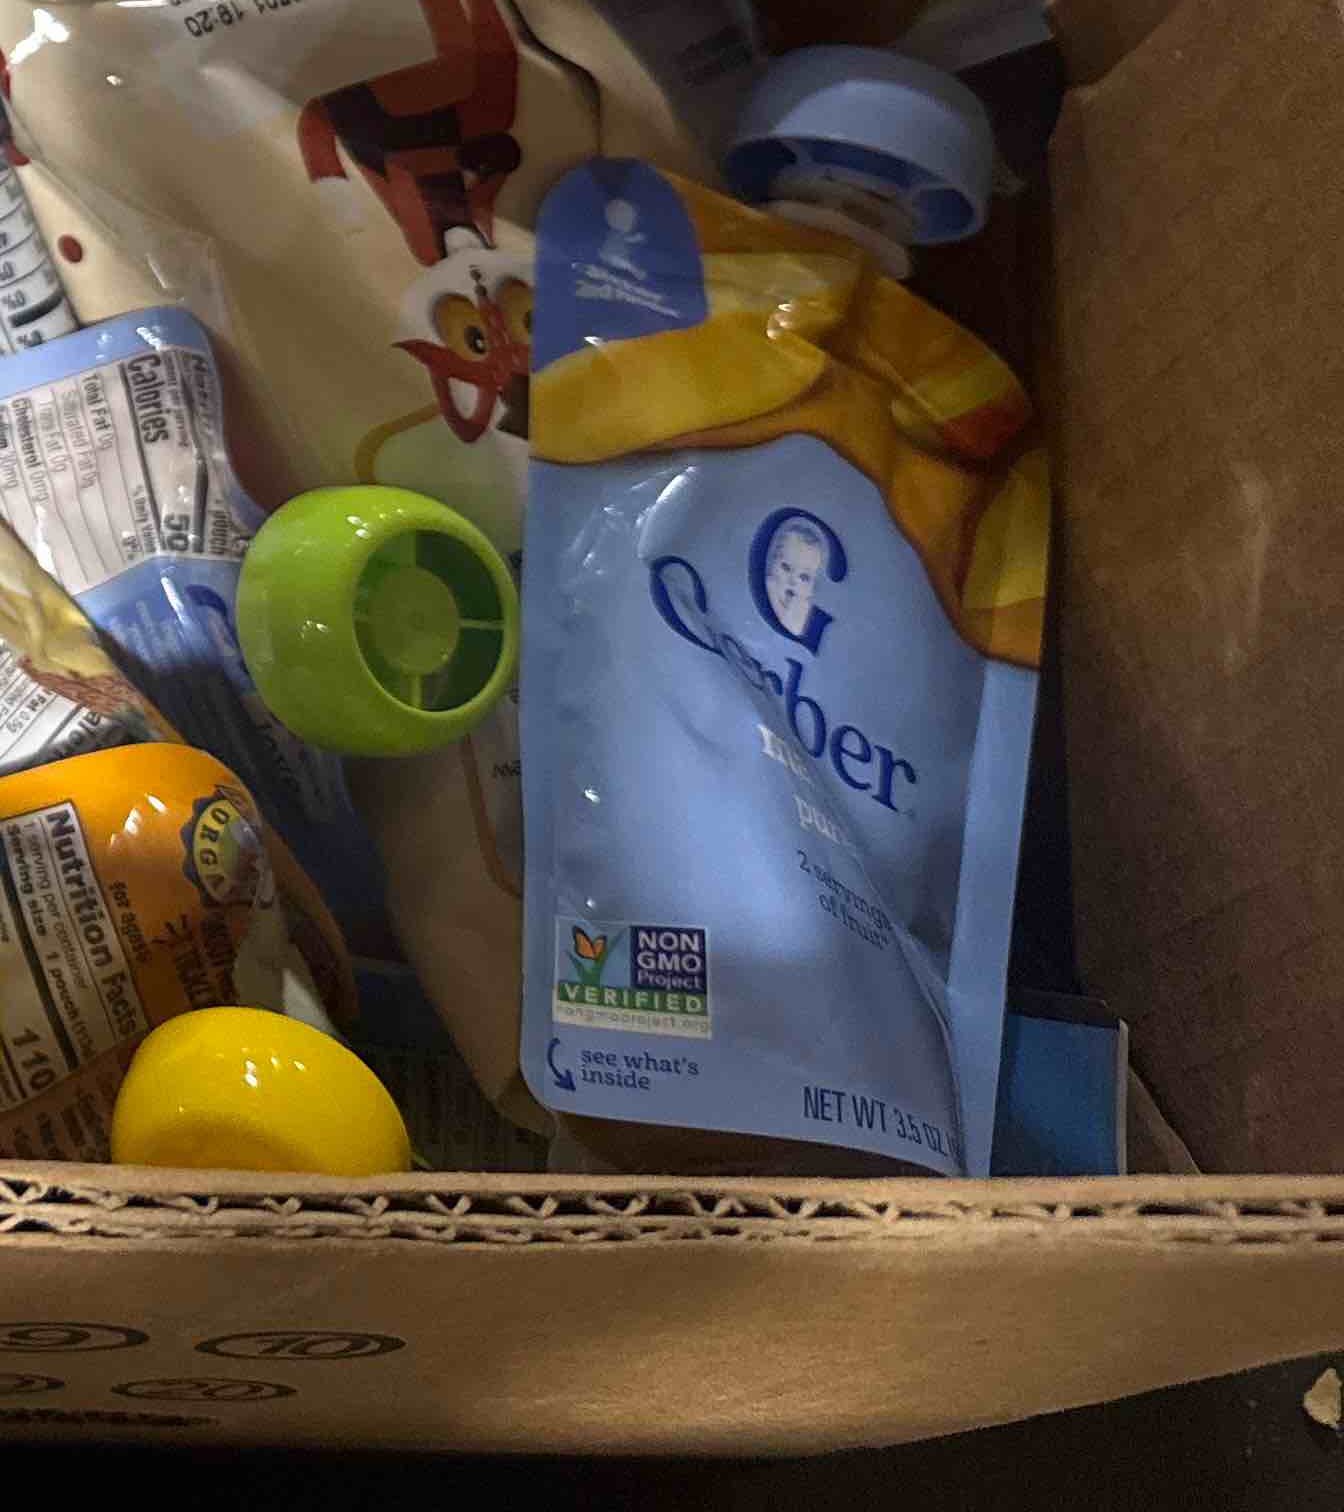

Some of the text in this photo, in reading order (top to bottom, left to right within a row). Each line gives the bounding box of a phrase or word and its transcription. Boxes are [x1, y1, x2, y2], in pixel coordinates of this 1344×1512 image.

[126, 353, 190, 554] Calories 50
[46, 809, 113, 969] Nutrition
[102, 969, 141, 1038] Facts
[636, 927, 701, 953] NON
[635, 950, 703, 974] GMO
[636, 969, 703, 990] Project
[563, 982, 706, 1014] VERIFIED
[12, 1028, 56, 1090] 110
[580, 1048, 700, 1077] see what's
[580, 1064, 652, 1091] inside
[802, 1085, 924, 1147] NET WT 3.5
[252, 1333, 374, 1357] 10
